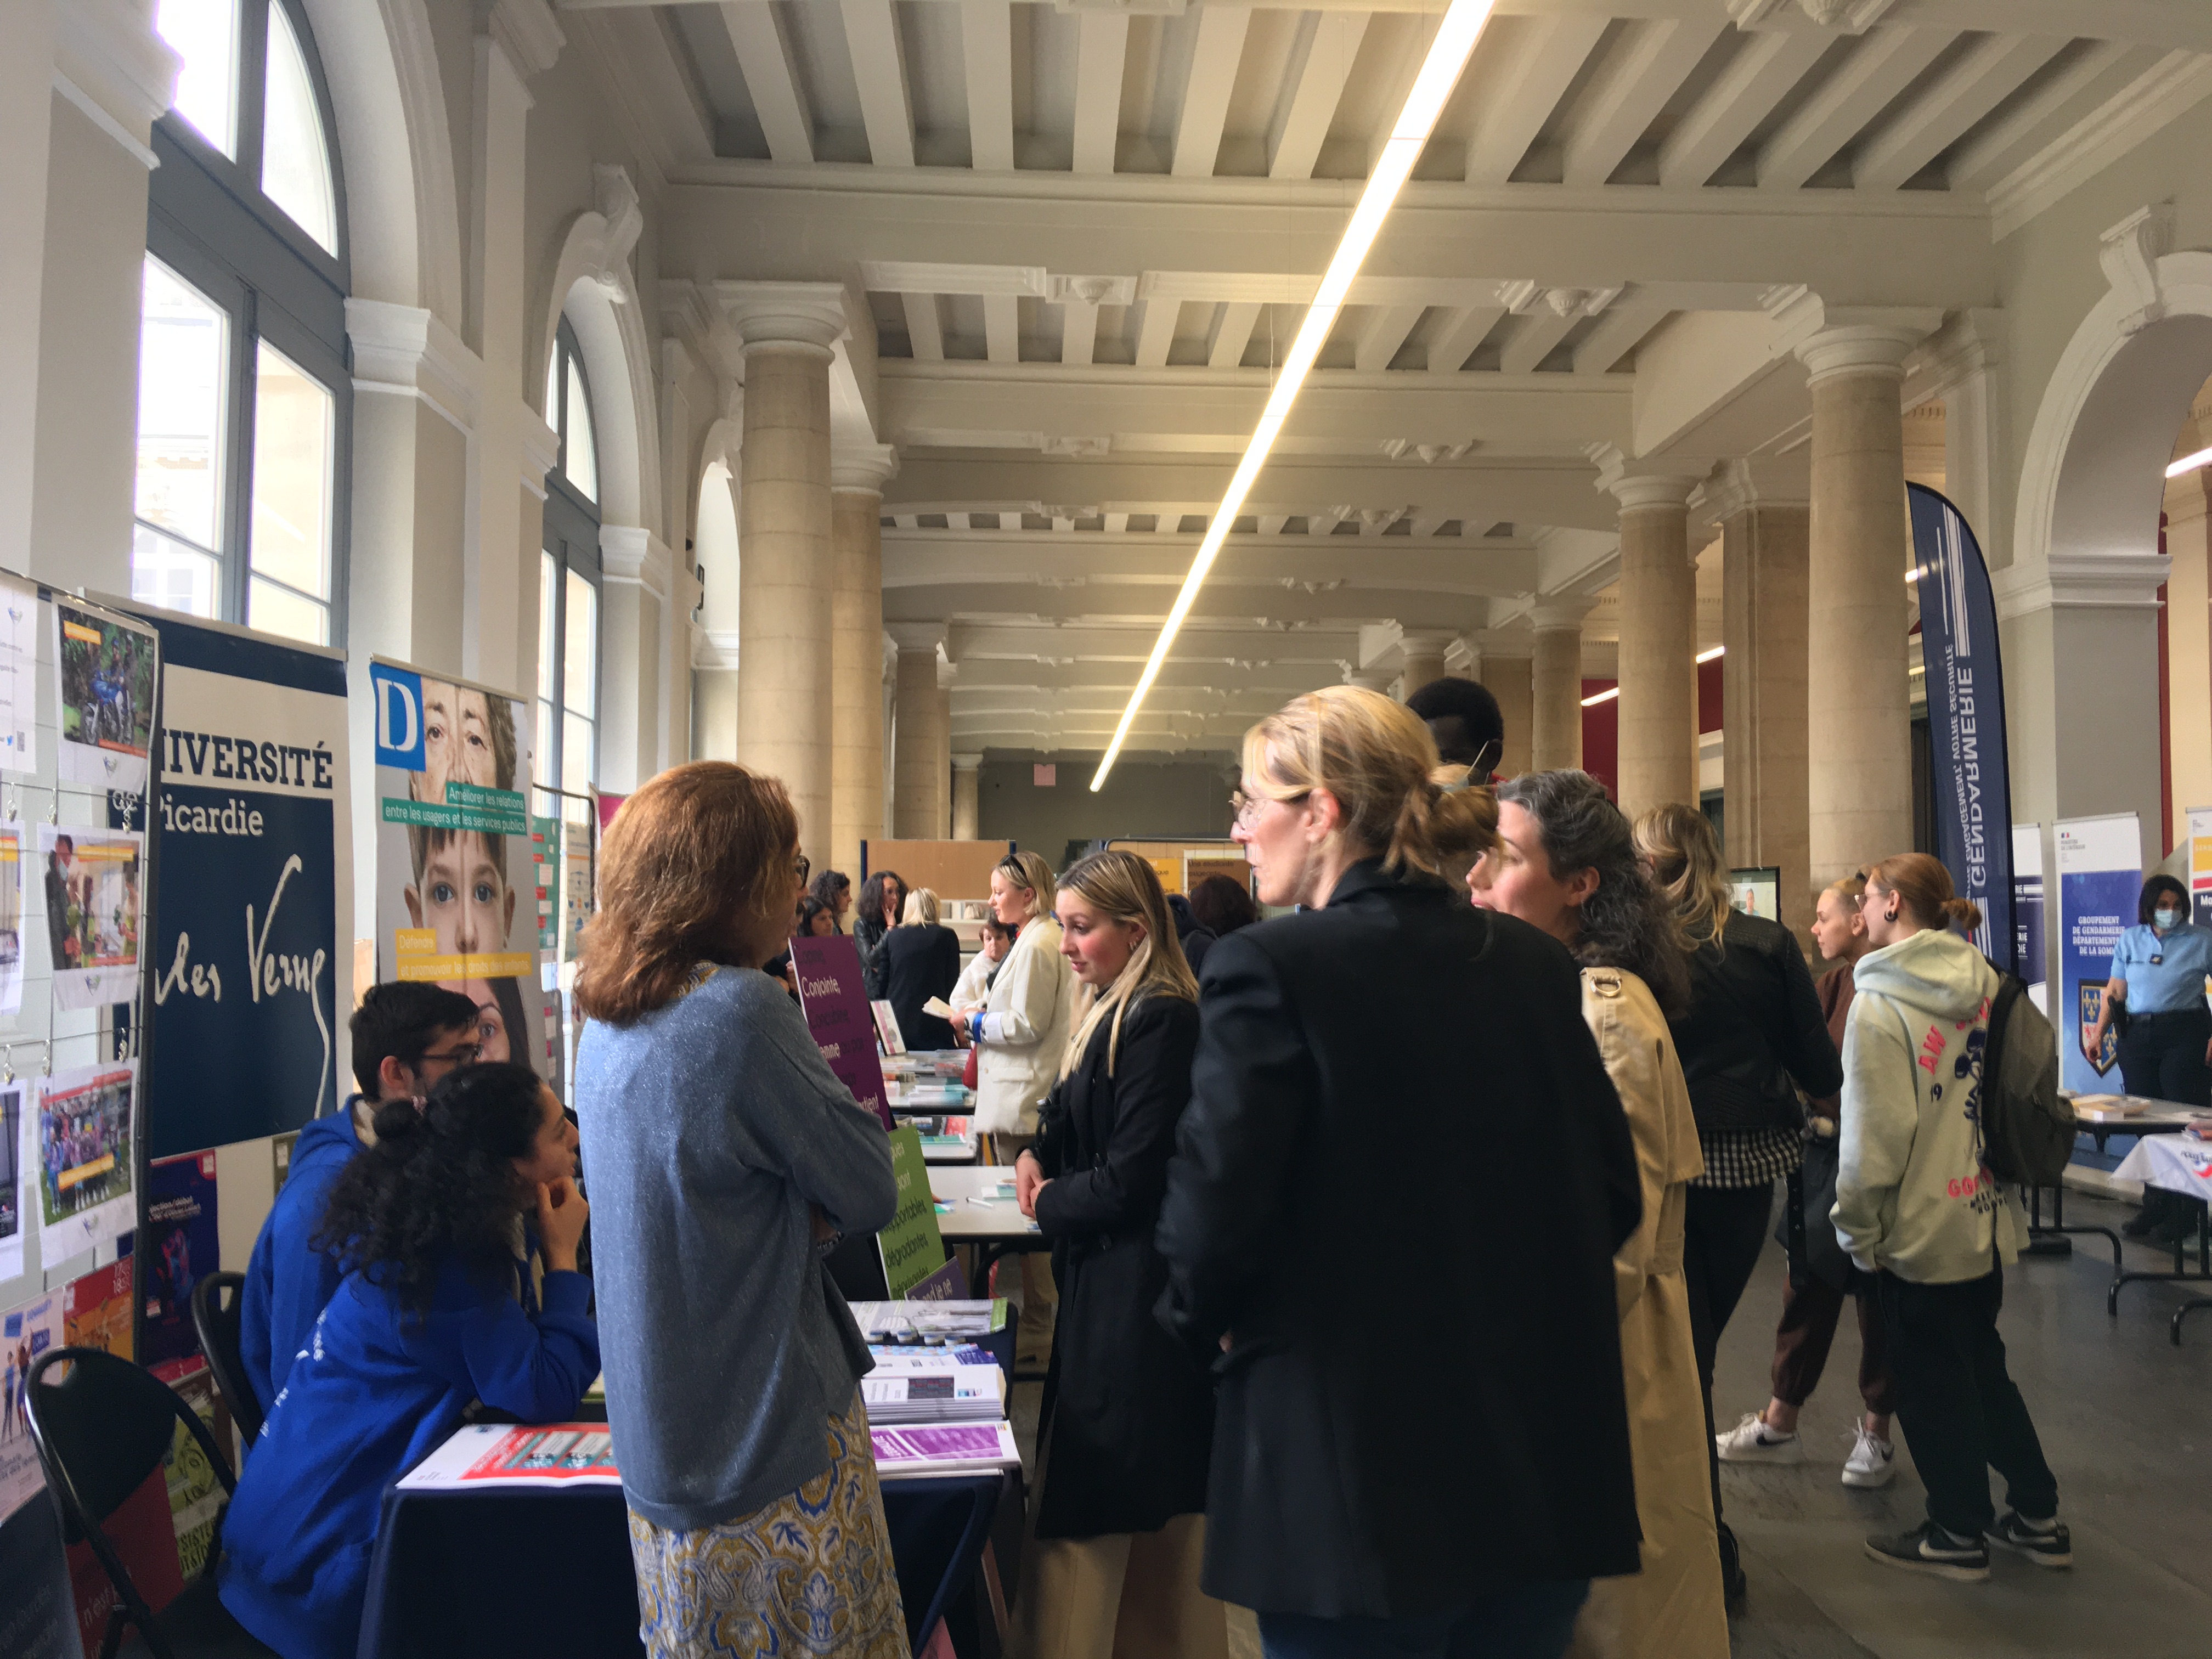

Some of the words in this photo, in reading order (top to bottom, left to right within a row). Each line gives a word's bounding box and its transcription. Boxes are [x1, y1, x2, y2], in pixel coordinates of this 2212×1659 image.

[376, 678, 418, 752] D
[162, 728, 333, 789] IVERSITÉ
[449, 786, 484, 804] Améliorer
[486, 791, 496, 806] les
[496, 795, 524, 810] relations
[160, 793, 264, 837] icardie
[385, 805, 408, 820] entre
[409, 805, 421, 821] les
[422, 810, 450, 827] usagers
[452, 812, 461, 824] et
[462, 811, 472, 826] les
[473, 815, 501, 829] services
[502, 819, 526, 832] publics
[2073, 926, 2081, 934] DE
[2078, 916, 2120, 924] GROUPEMENT
[2079, 946, 2087, 955] DE
[2089, 946, 2097, 955] LA
[400, 964, 409, 977] et
[411, 962, 452, 979] promouvoir
[454, 961, 466, 974] les
[468, 960, 488, 974] droits
[490, 961, 503, 972] des
[802, 975, 841, 998] Conjointe,
[816, 1041, 841, 1060] emme
